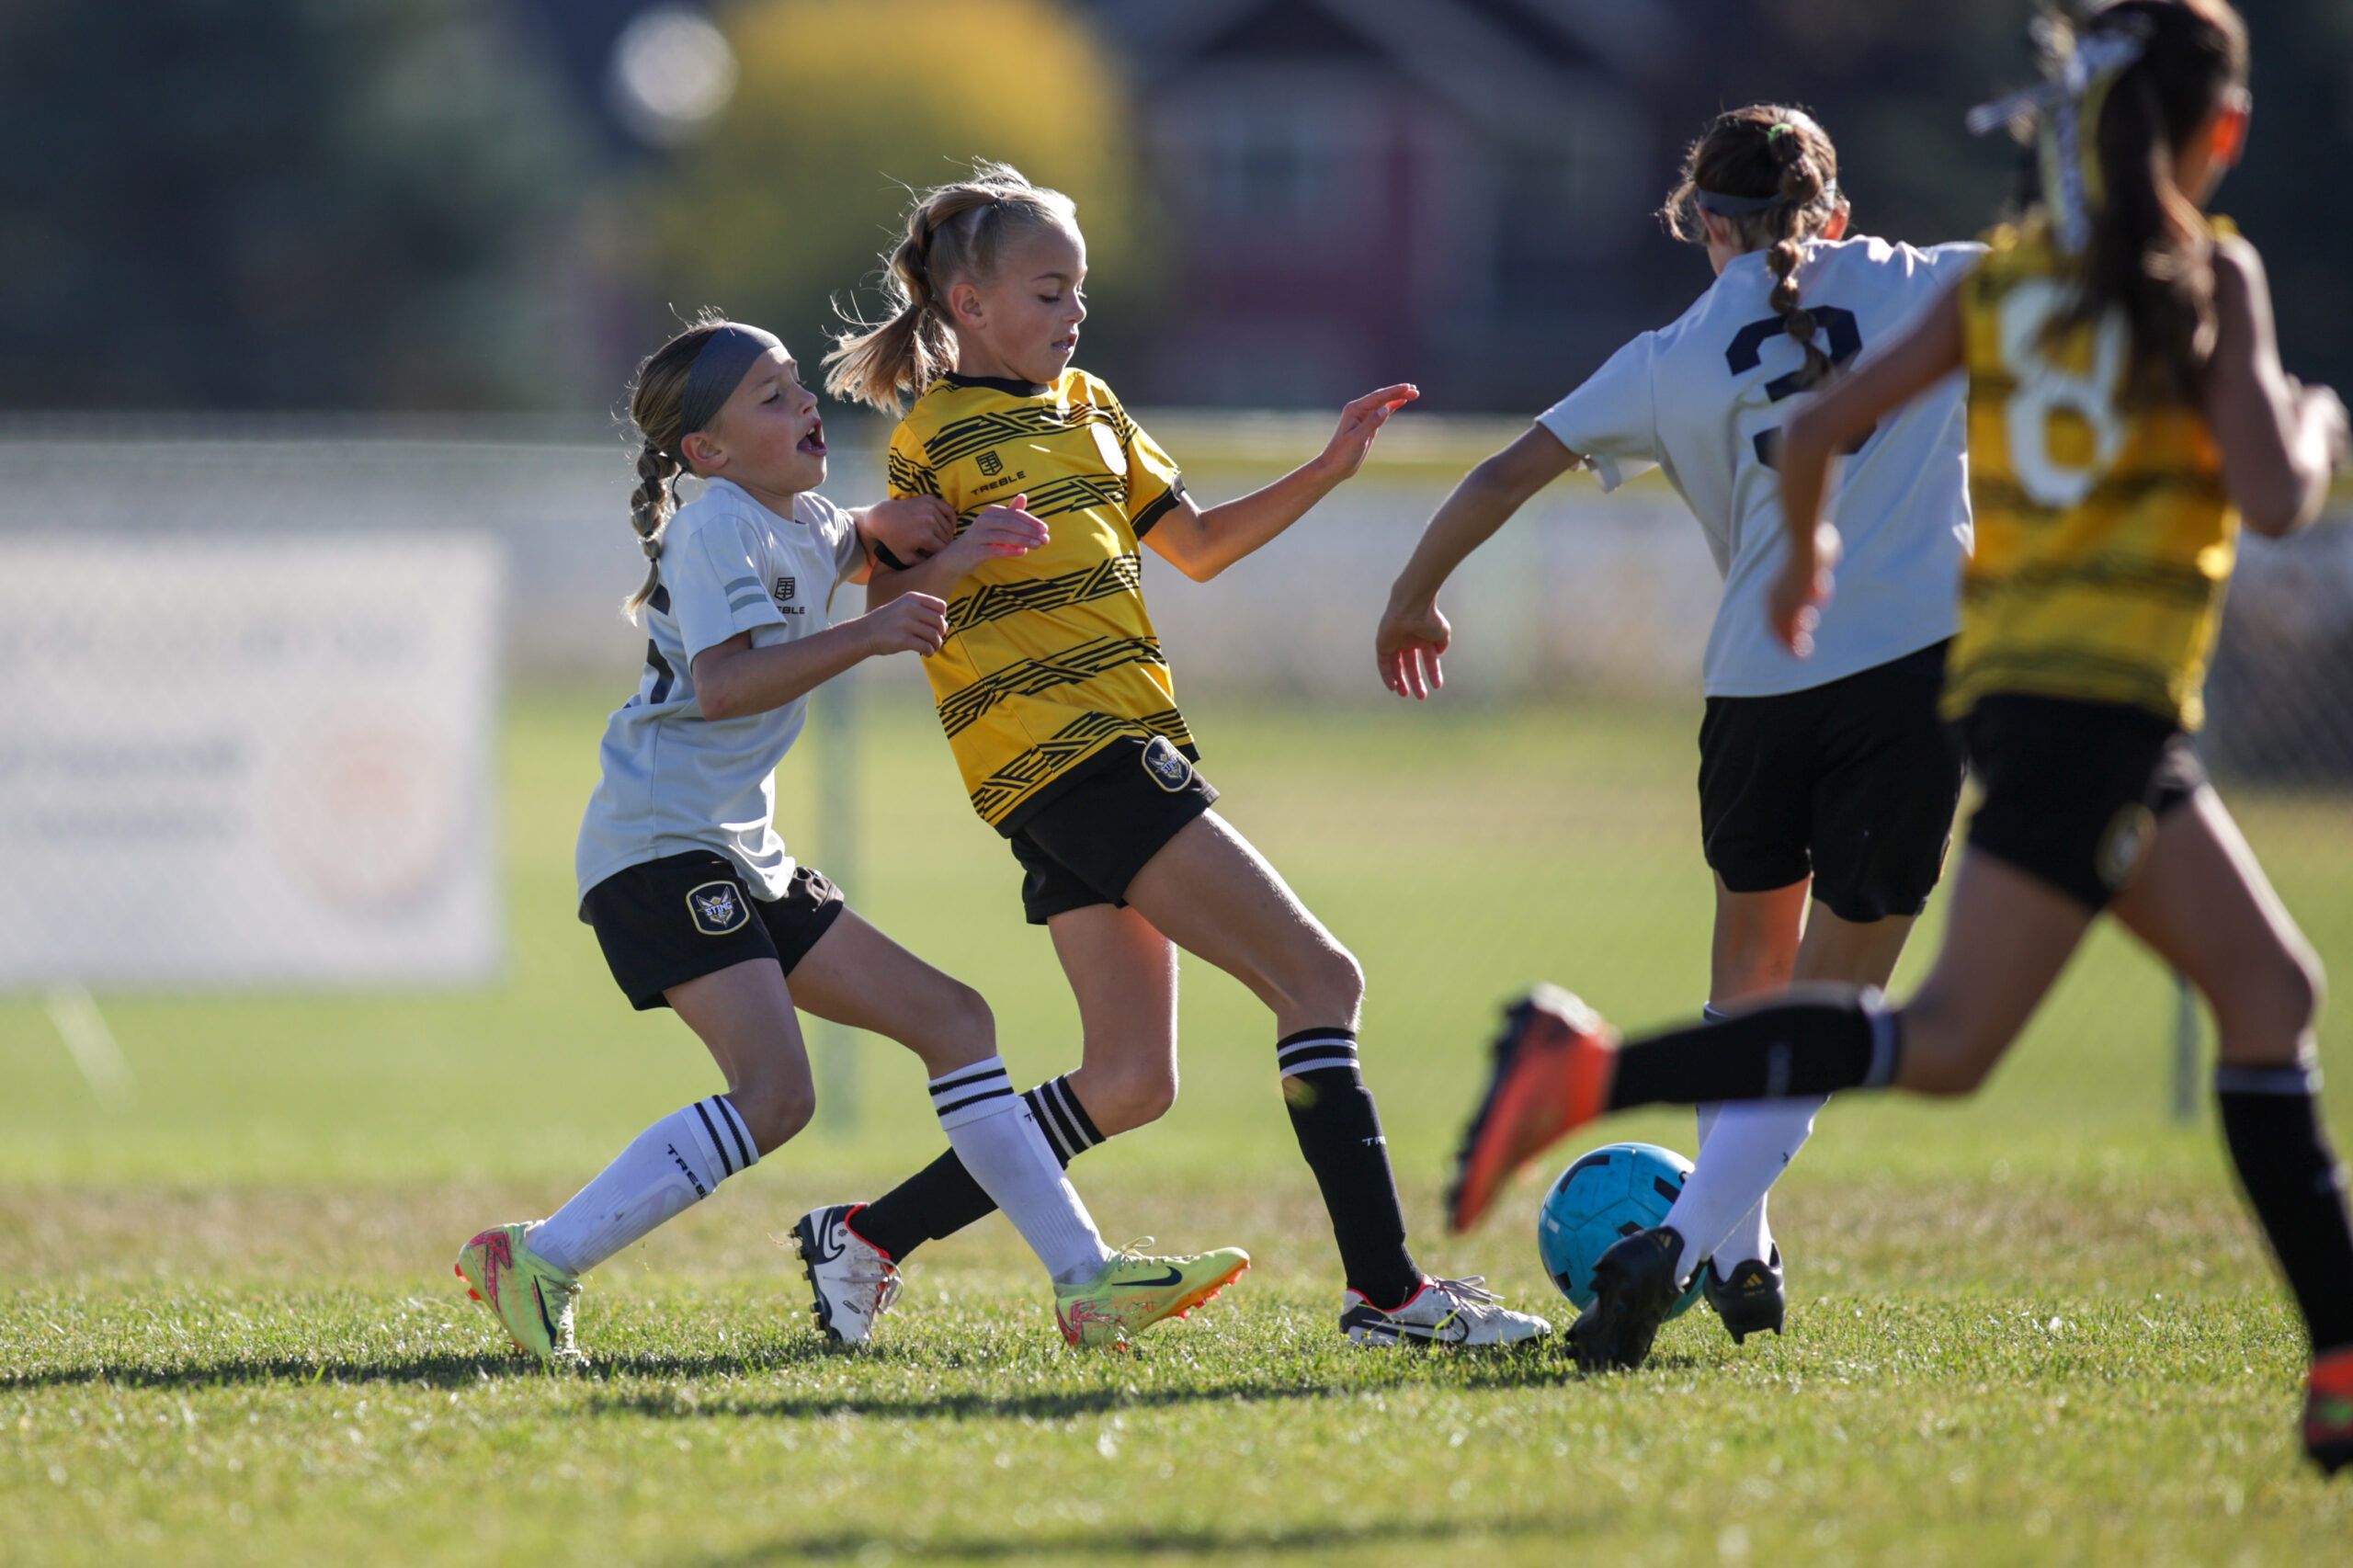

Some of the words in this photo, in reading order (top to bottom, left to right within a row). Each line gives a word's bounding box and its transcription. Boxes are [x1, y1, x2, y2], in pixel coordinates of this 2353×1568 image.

[1998, 280, 2129, 506] 8
[971, 470, 1026, 495] TREBLE
[705, 901, 733, 916] STING
[667, 1142, 707, 1200] TREB
